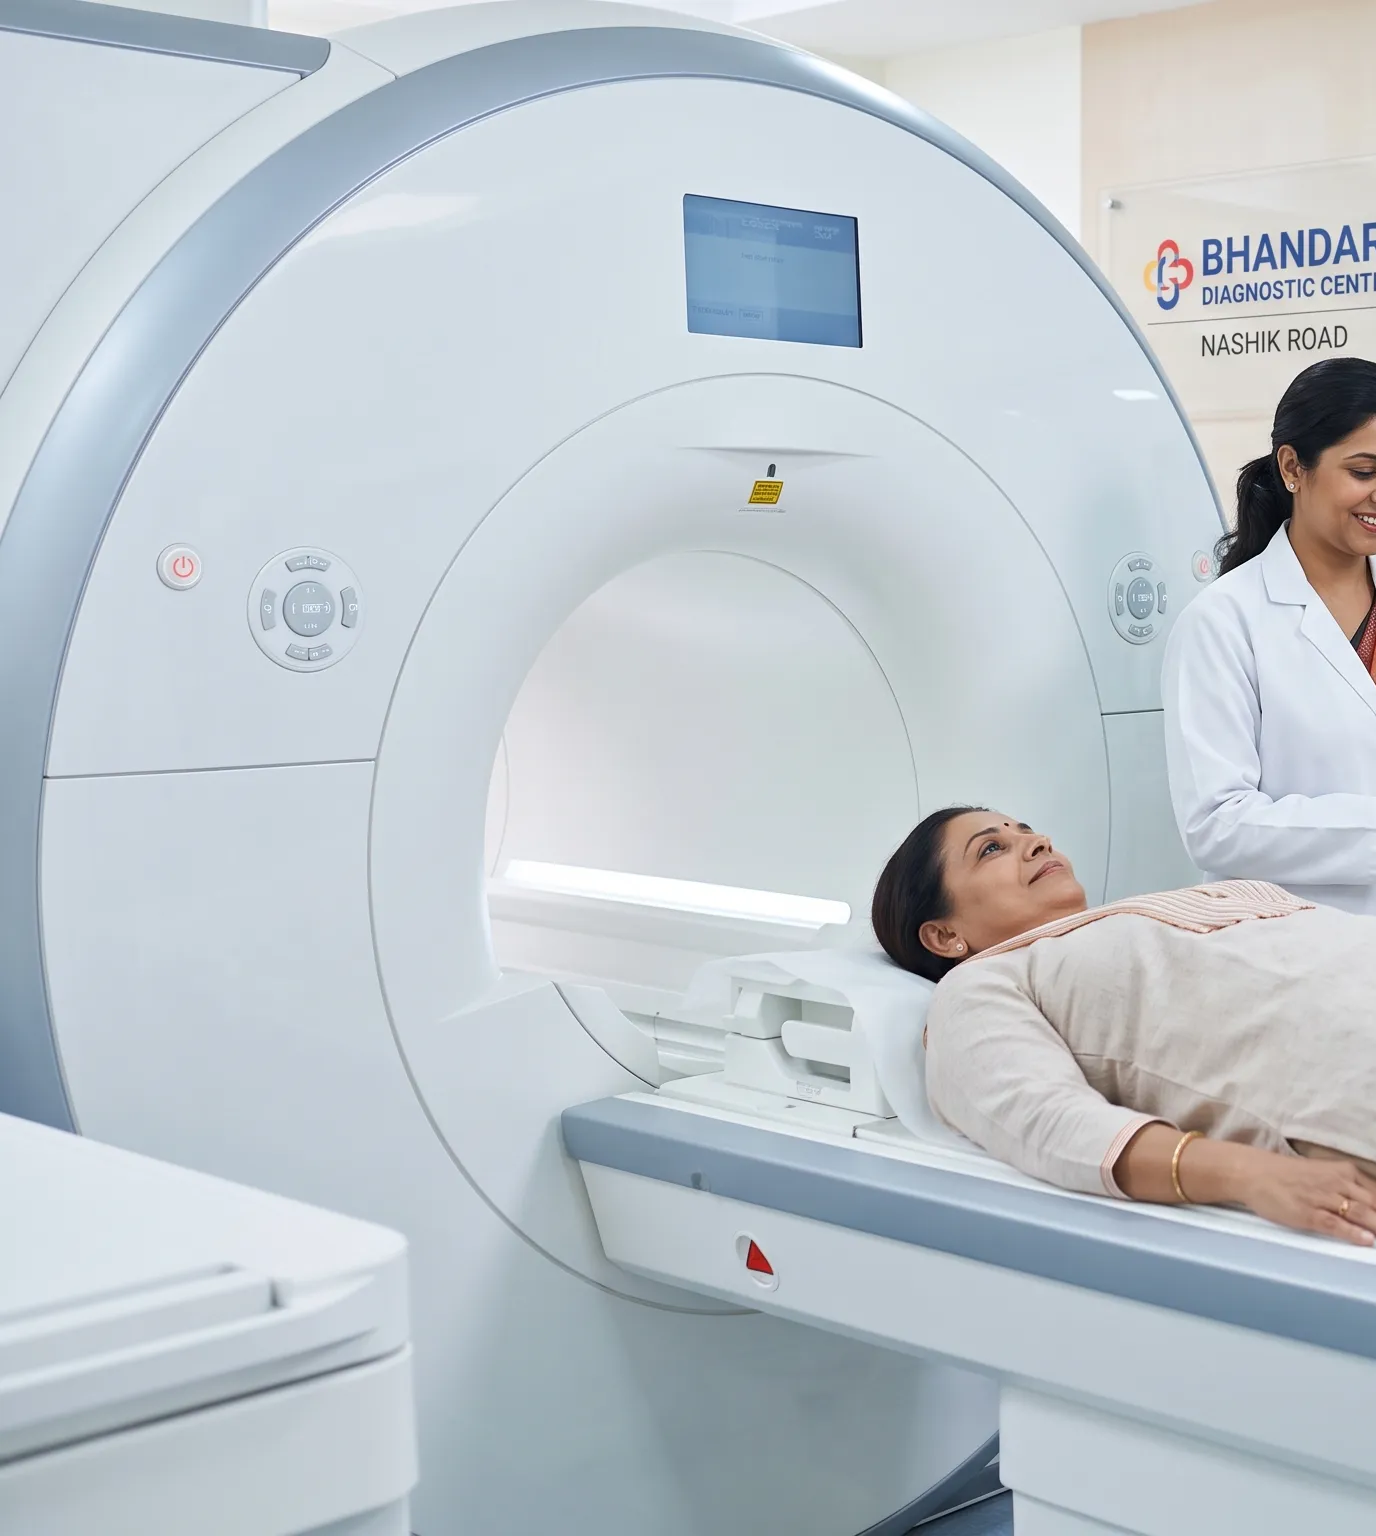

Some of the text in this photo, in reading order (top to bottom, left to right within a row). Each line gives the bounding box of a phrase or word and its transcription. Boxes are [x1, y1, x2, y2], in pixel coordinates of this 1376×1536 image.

[1202, 277, 1315, 305] DIAGNOSTIC
[1201, 325, 1348, 357] NASHIK ROAD
